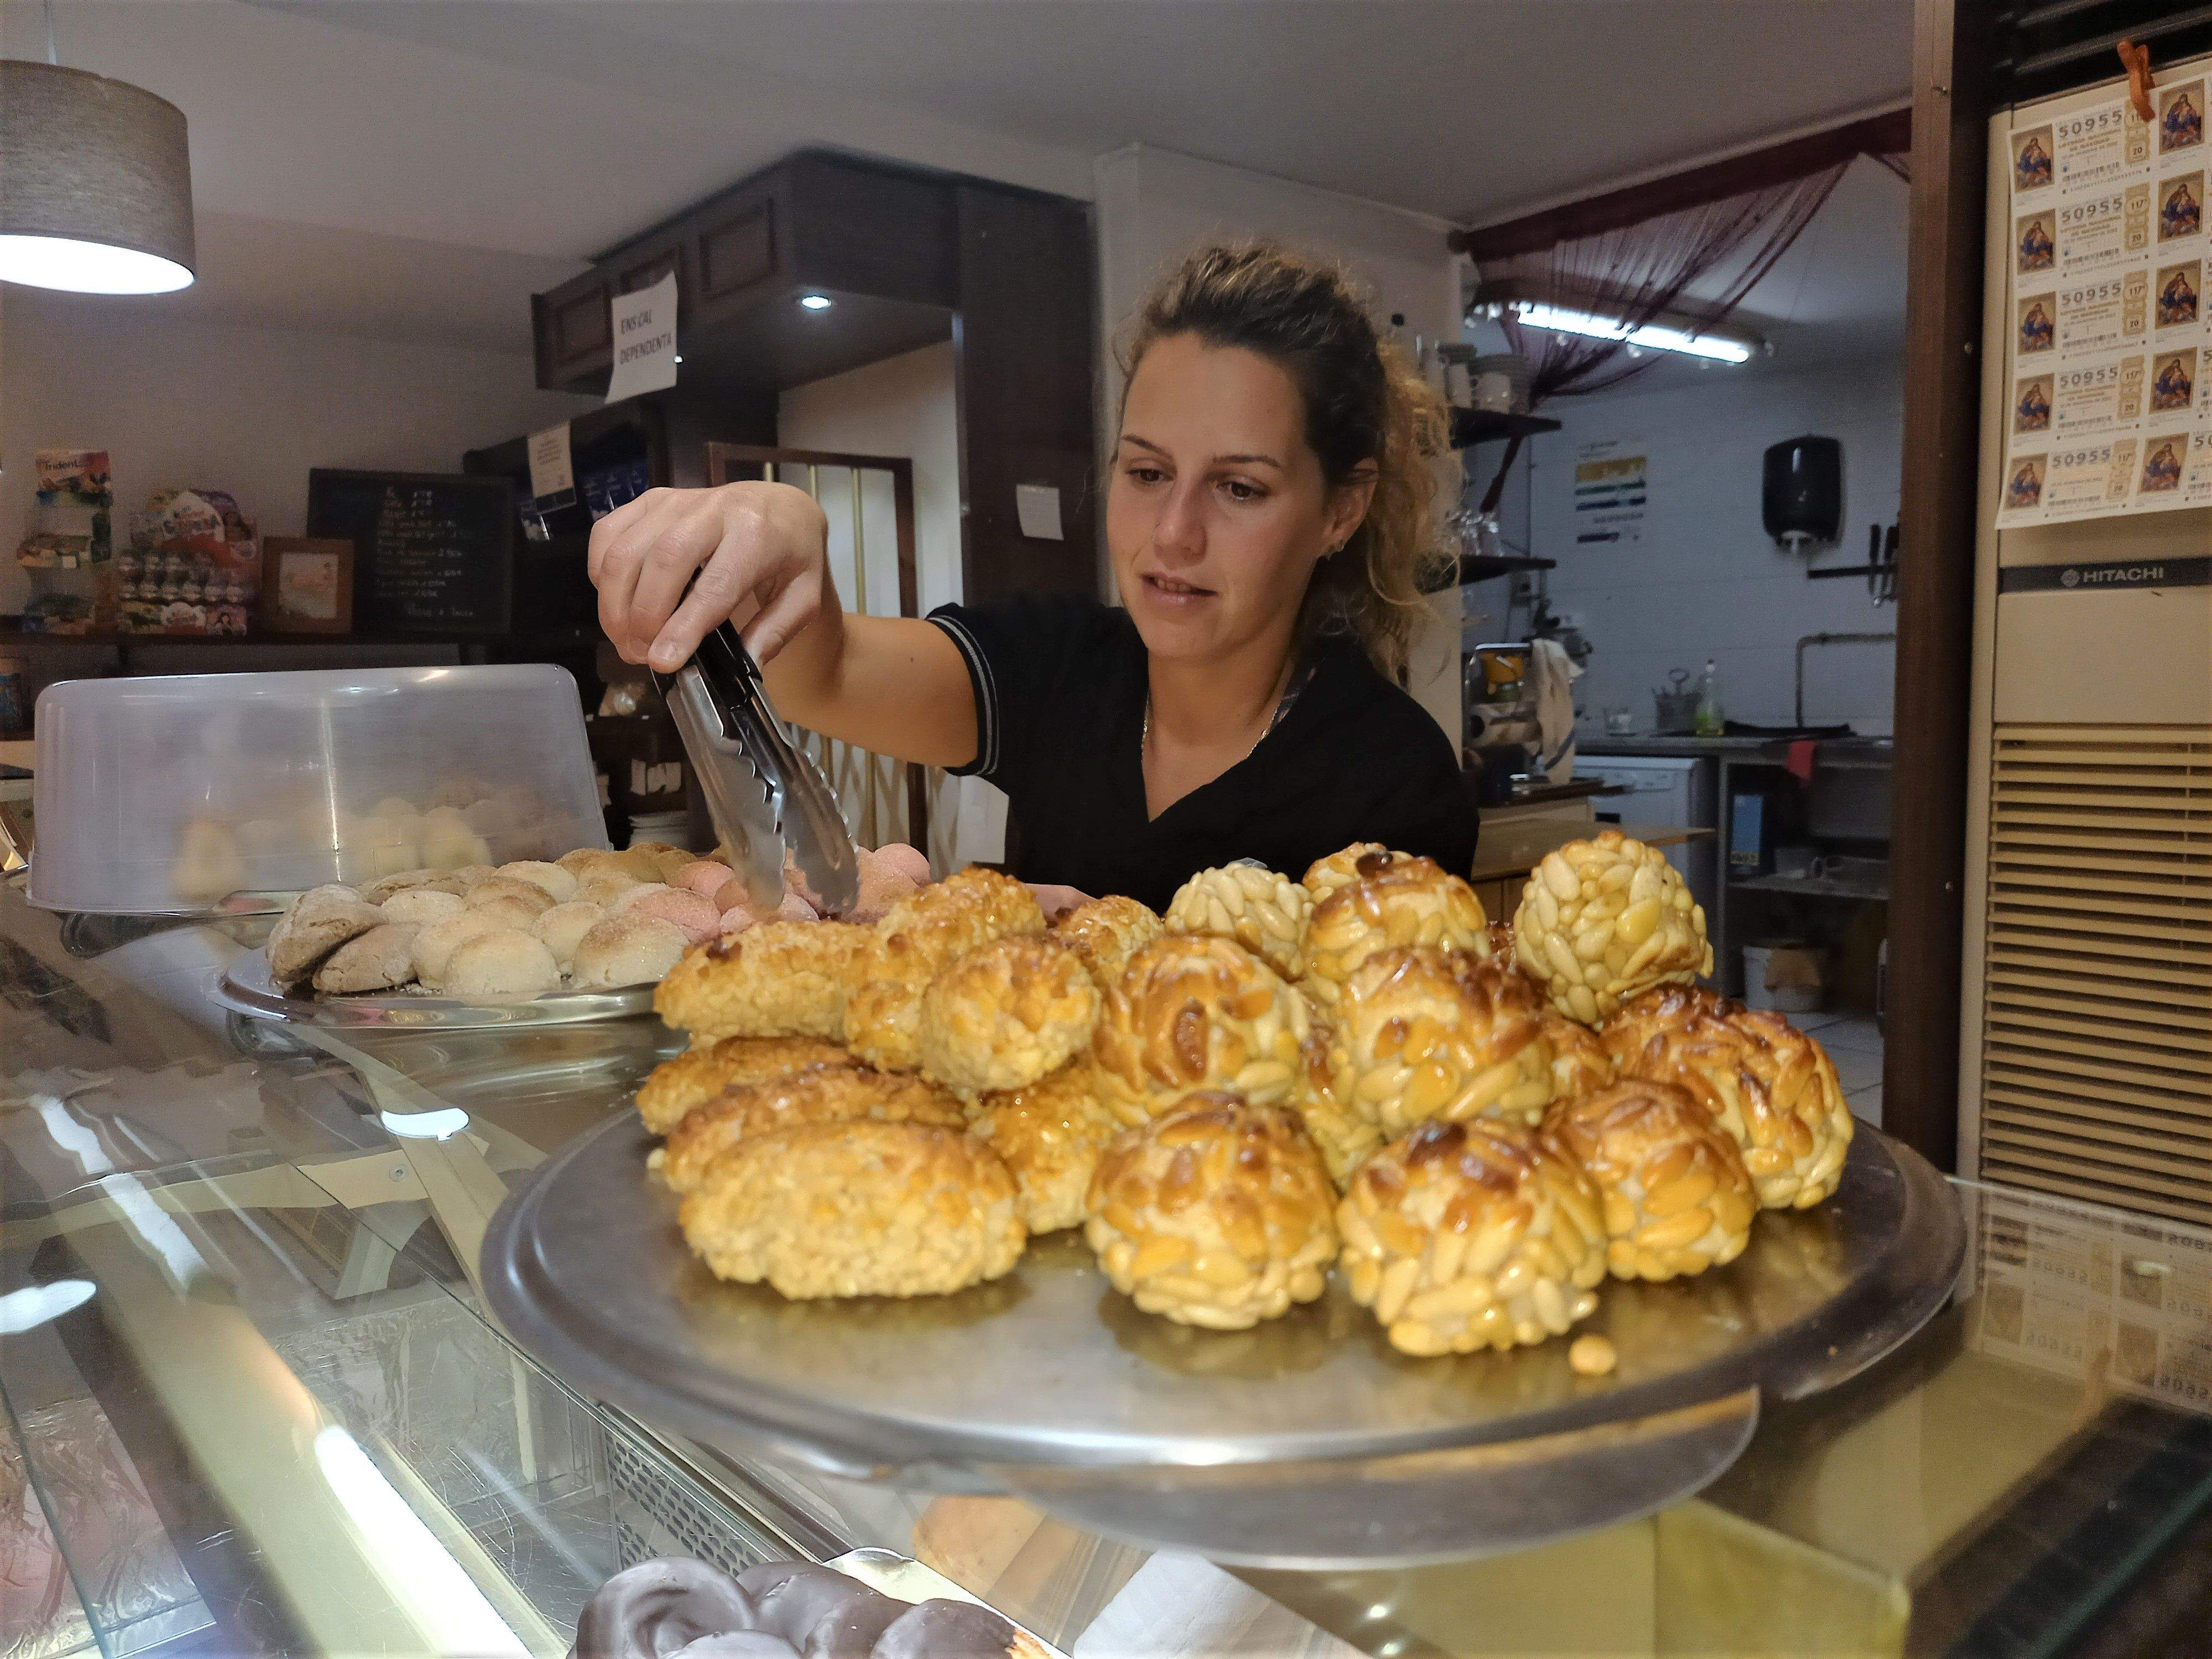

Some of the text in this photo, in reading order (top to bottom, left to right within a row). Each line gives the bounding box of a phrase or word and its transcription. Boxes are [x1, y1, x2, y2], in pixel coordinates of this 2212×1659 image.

[2058, 109, 2122, 138] 50955
[2061, 197, 2124, 223] 50955
[2061, 282, 2122, 306] 50955
[2059, 366, 2119, 389] 50955
[2051, 448, 2111, 469] 50955
[2083, 566, 2164, 583] HITACHI
